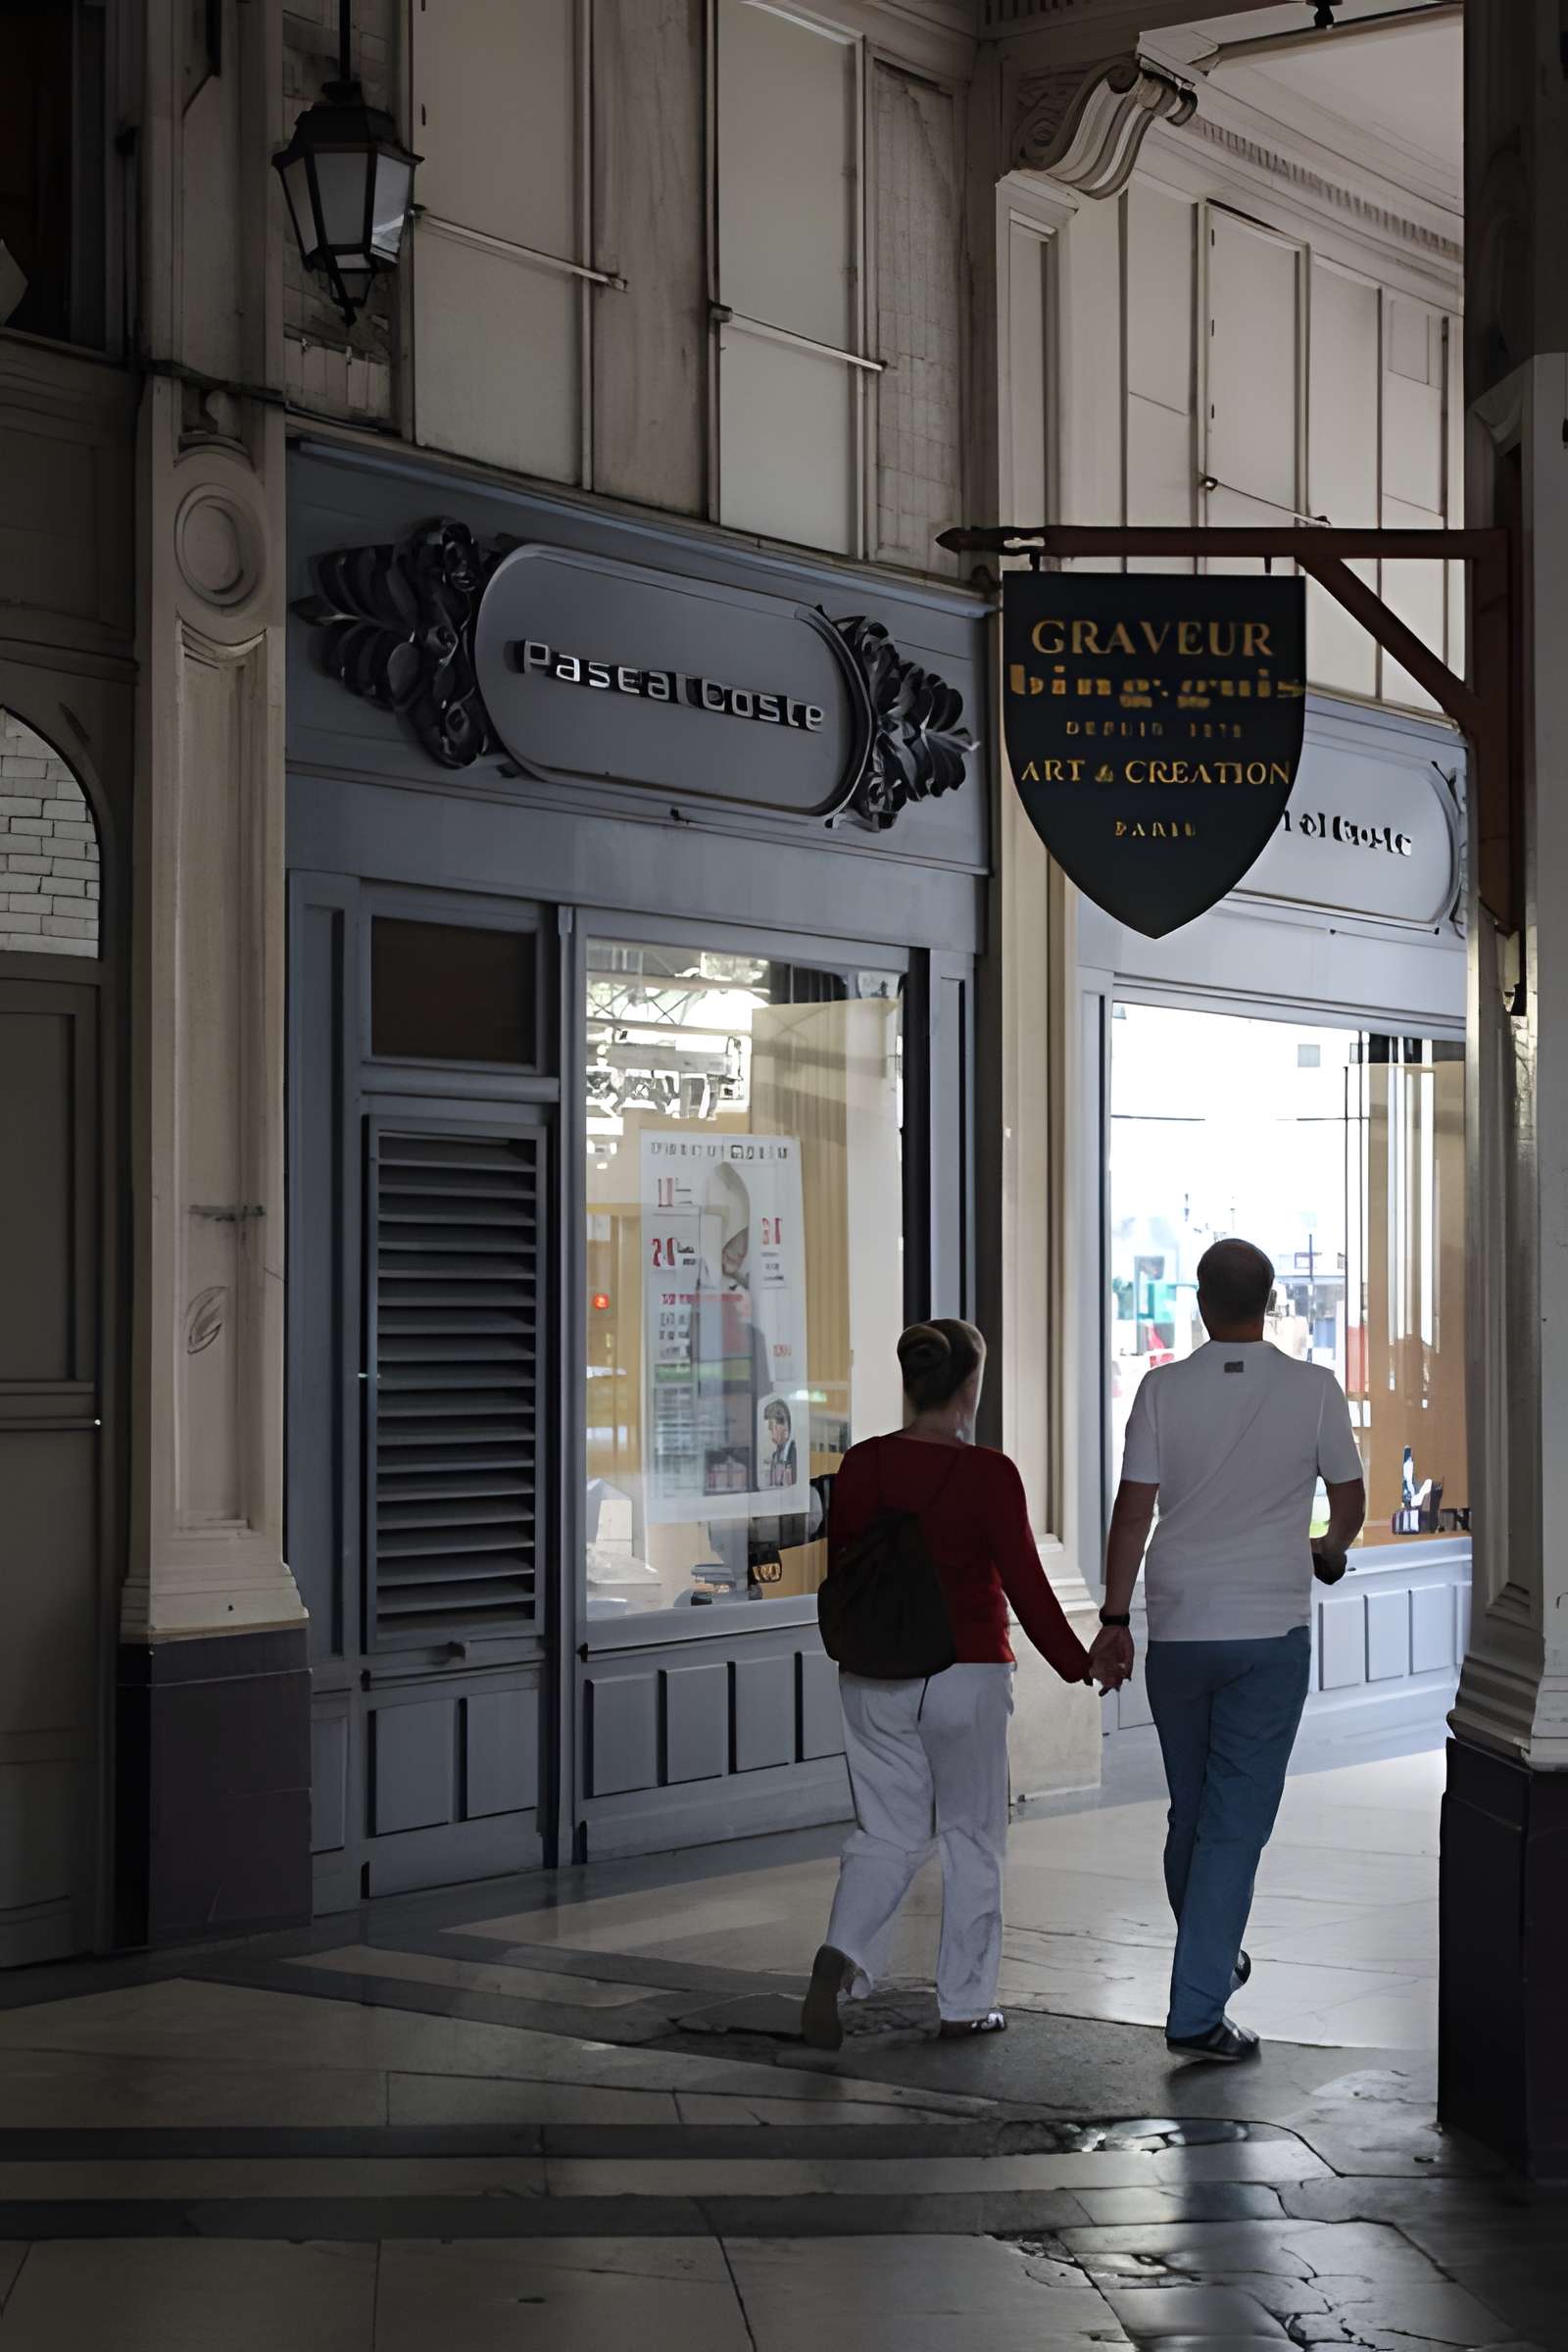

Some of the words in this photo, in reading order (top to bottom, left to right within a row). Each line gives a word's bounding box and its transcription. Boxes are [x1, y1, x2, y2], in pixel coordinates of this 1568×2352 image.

[1031, 620, 1274, 657] GRAVEUR
[1020, 760, 1086, 782] ART
[1125, 760, 1291, 785] CREATION
